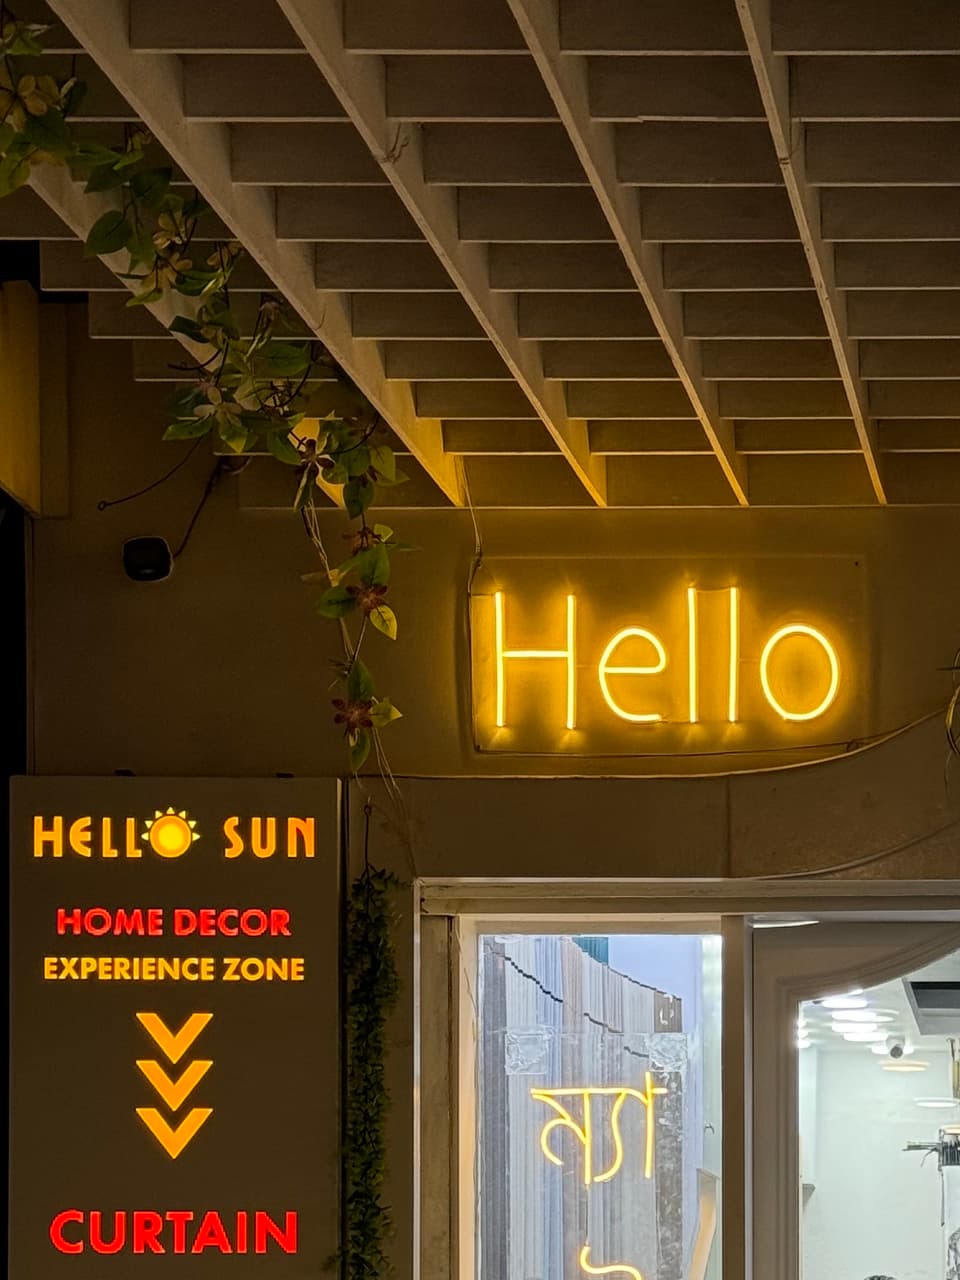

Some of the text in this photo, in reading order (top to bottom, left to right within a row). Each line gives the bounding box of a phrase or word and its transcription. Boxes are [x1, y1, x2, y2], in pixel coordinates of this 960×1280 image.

[492, 585, 841, 731] Hello
[32, 806, 316, 859] HELLO SUN
[55, 907, 292, 937] HOME DECOR
[43, 956, 305, 982] EXPERIENCE ZONE
[49, 1208, 299, 1256] CURTAIN
